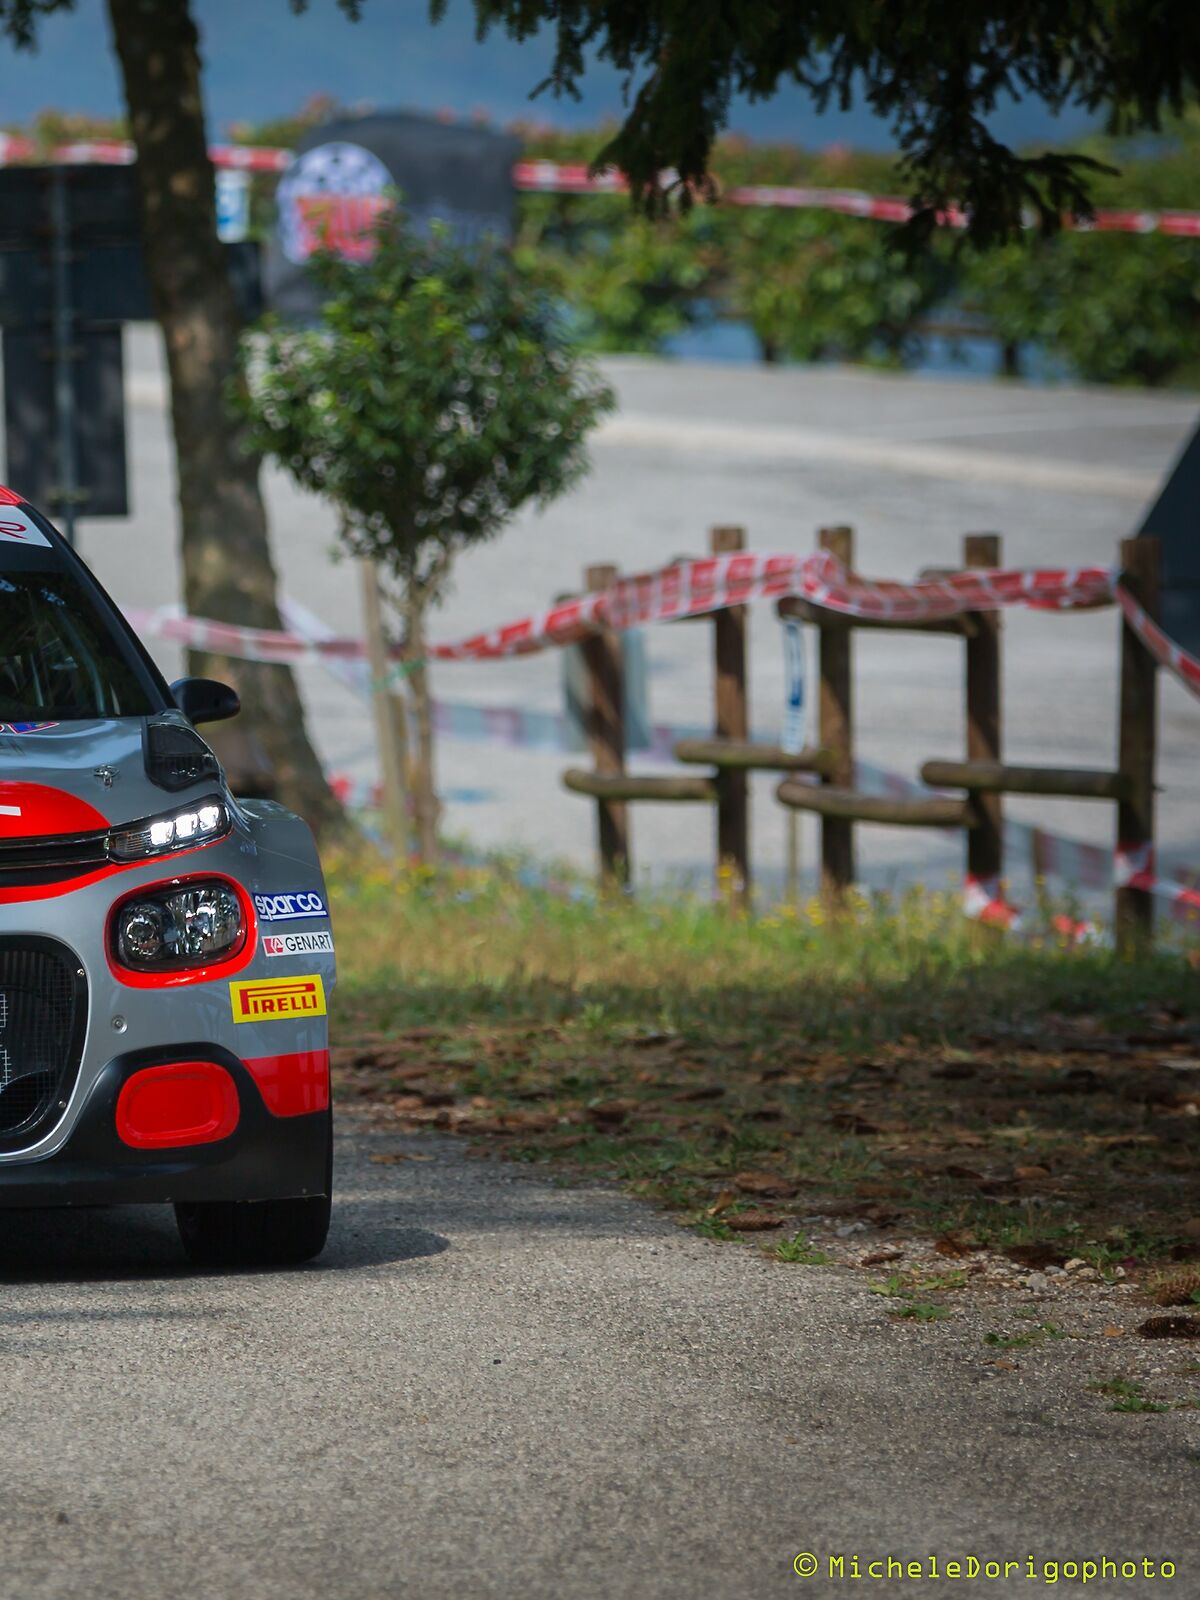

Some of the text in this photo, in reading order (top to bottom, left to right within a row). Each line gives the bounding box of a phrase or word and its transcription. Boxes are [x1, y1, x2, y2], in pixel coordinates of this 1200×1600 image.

[254, 893, 323, 920] sparco
[285, 934, 332, 952] GENART
[239, 982, 317, 1015] PIRELLI
